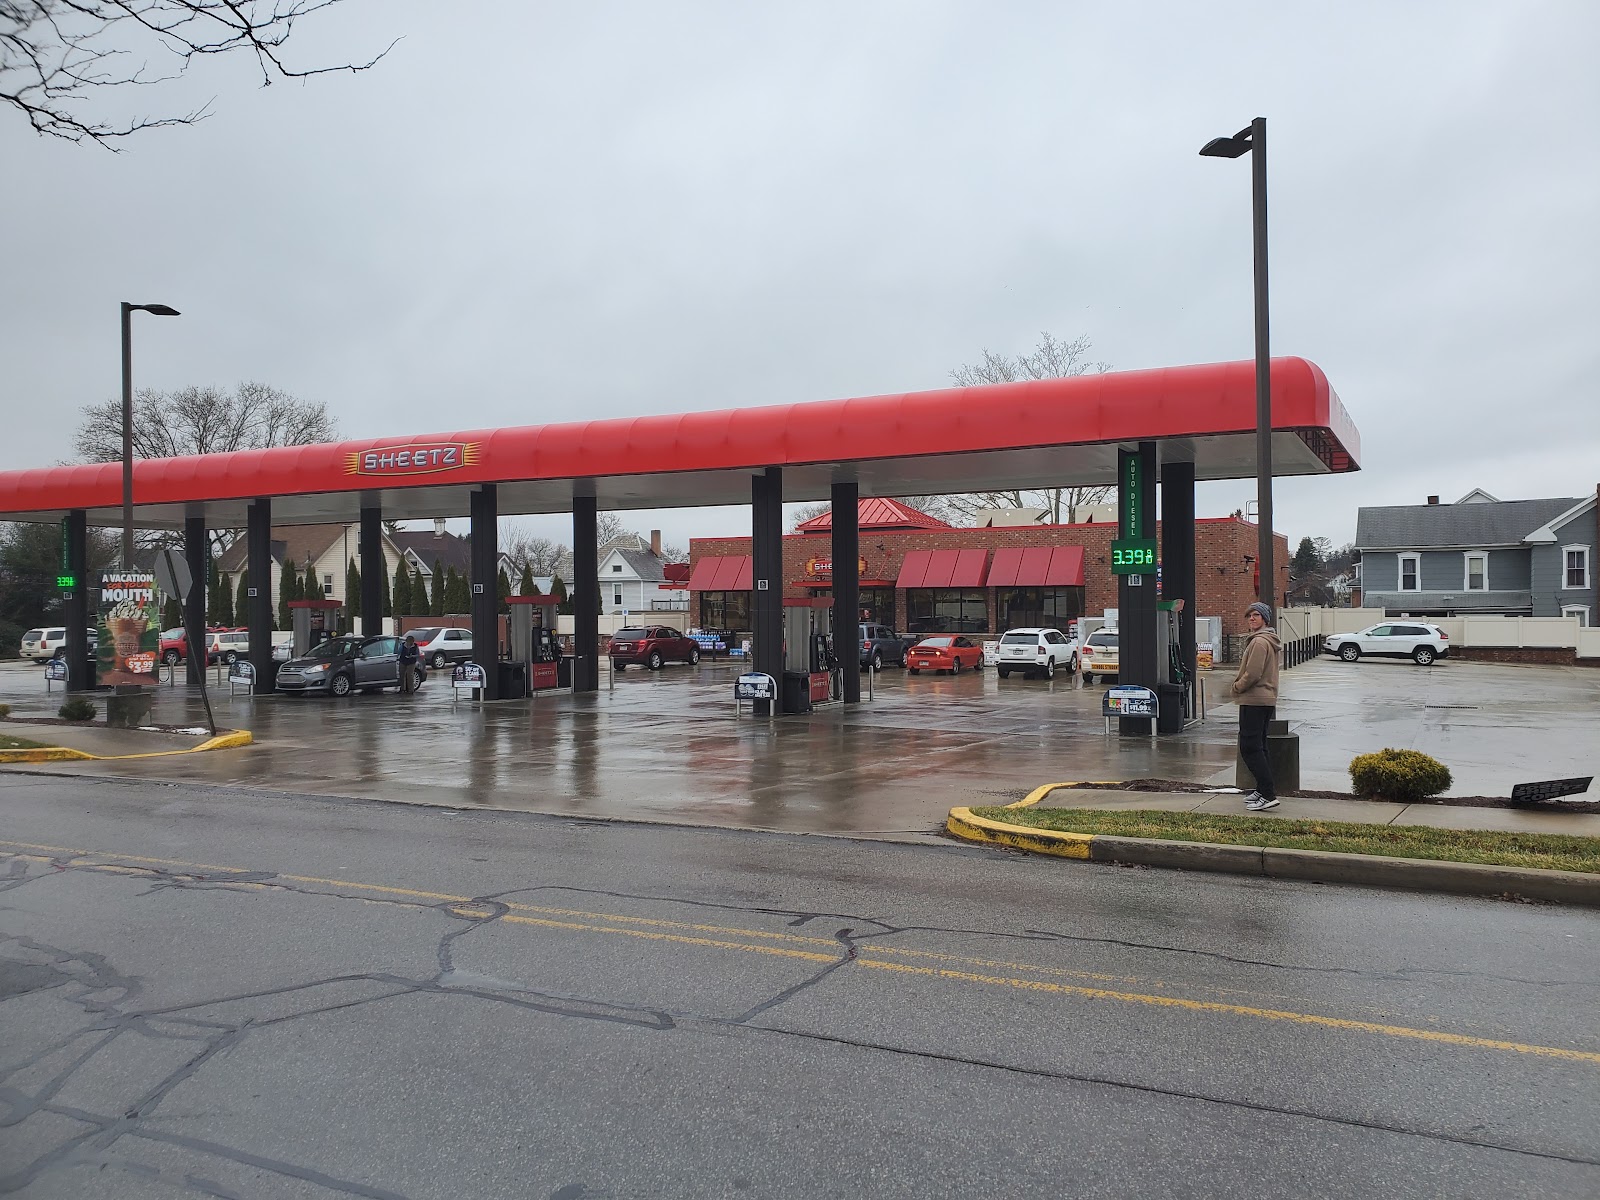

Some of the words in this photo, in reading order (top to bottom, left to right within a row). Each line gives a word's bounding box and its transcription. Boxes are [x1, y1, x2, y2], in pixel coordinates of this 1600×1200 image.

[365, 447, 457, 470] SHEETZ
[1113, 549, 1144, 565] 3.39
[101, 573, 108, 583] A
[109, 573, 154, 583] VACATION
[101, 588, 153, 602] MOUTH
[128, 660, 154, 674] $3.99
